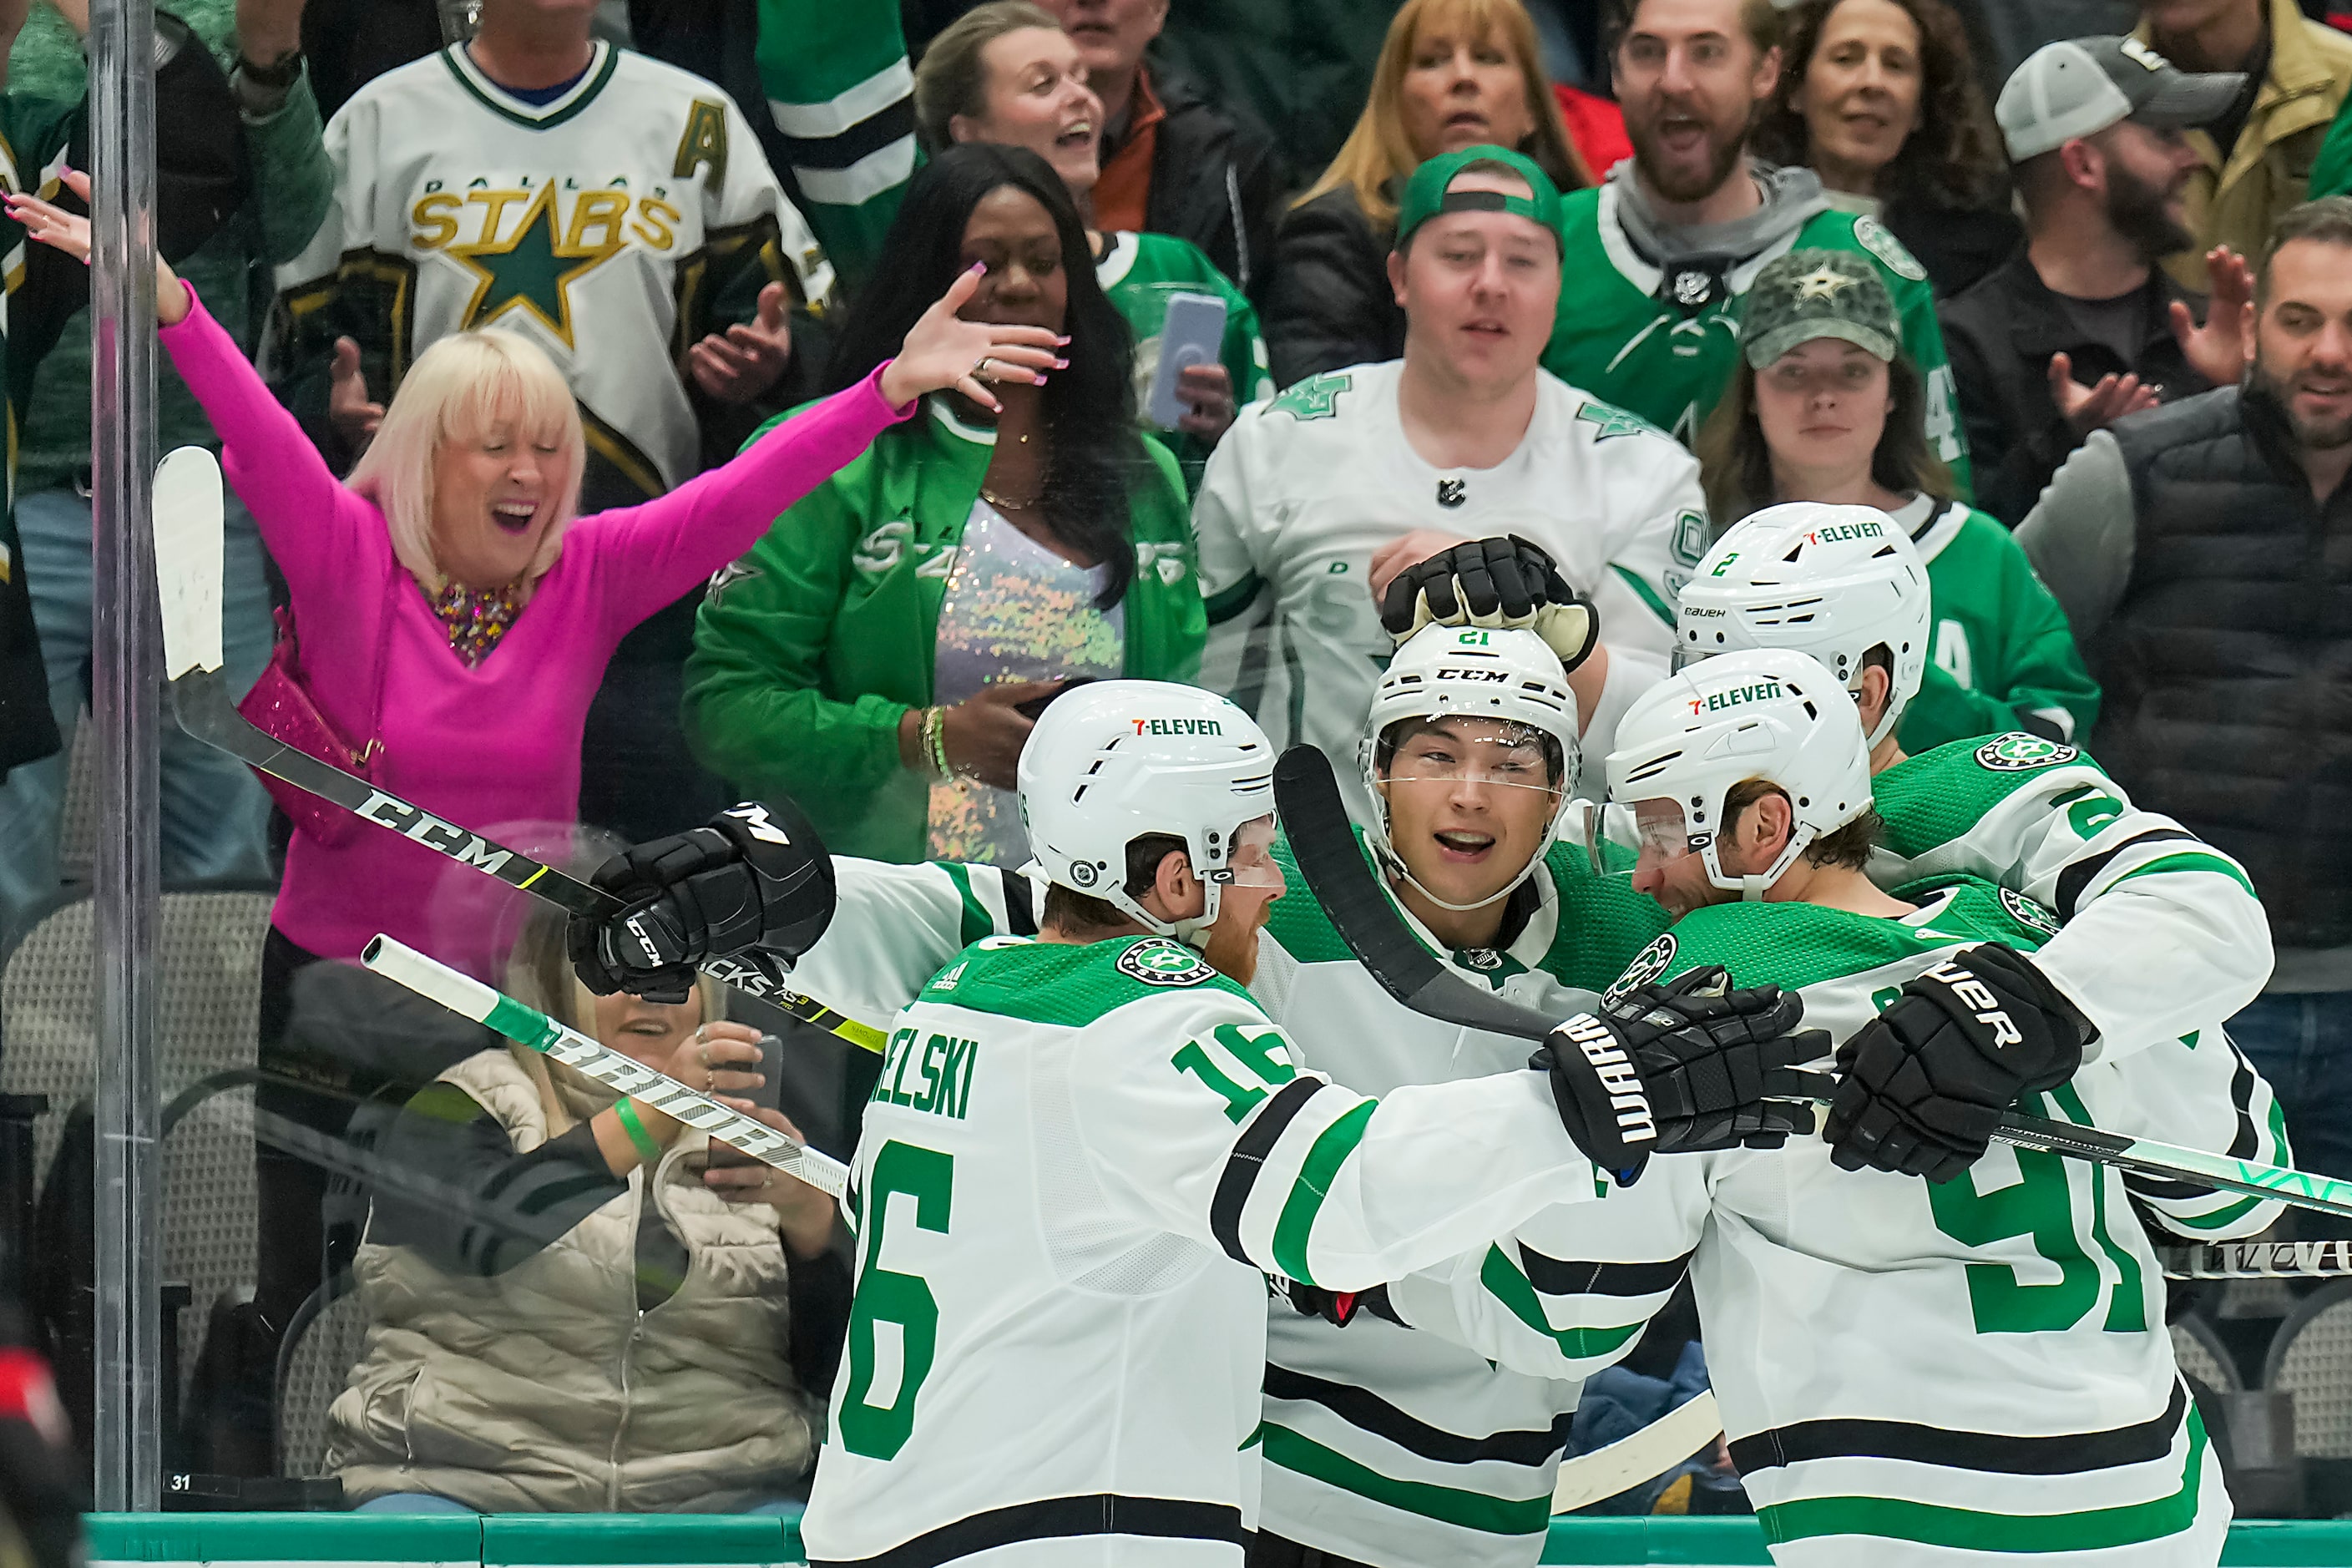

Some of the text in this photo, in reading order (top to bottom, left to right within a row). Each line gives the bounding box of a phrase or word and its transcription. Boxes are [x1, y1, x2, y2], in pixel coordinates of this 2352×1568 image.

[673, 99, 728, 193] A
[1803, 522, 1884, 545] 7-ELEVEN
[1711, 553, 1740, 577] 2
[1459, 630, 1490, 648] 21
[1436, 669, 1510, 684] CCM
[1687, 681, 1781, 716] 7-ELEVEN
[1131, 718, 1222, 736] 7-ELEVEN
[353, 787, 514, 876] CCM
[626, 918, 664, 968] CCM
[1914, 961, 2023, 1050] UER
[544, 1026, 788, 1158] RRIOR
[875, 1027, 979, 1120] ELSKI
[1171, 1023, 1297, 1125] 16
[838, 1138, 954, 1462] 6
[171, 1474, 190, 1491] 31
